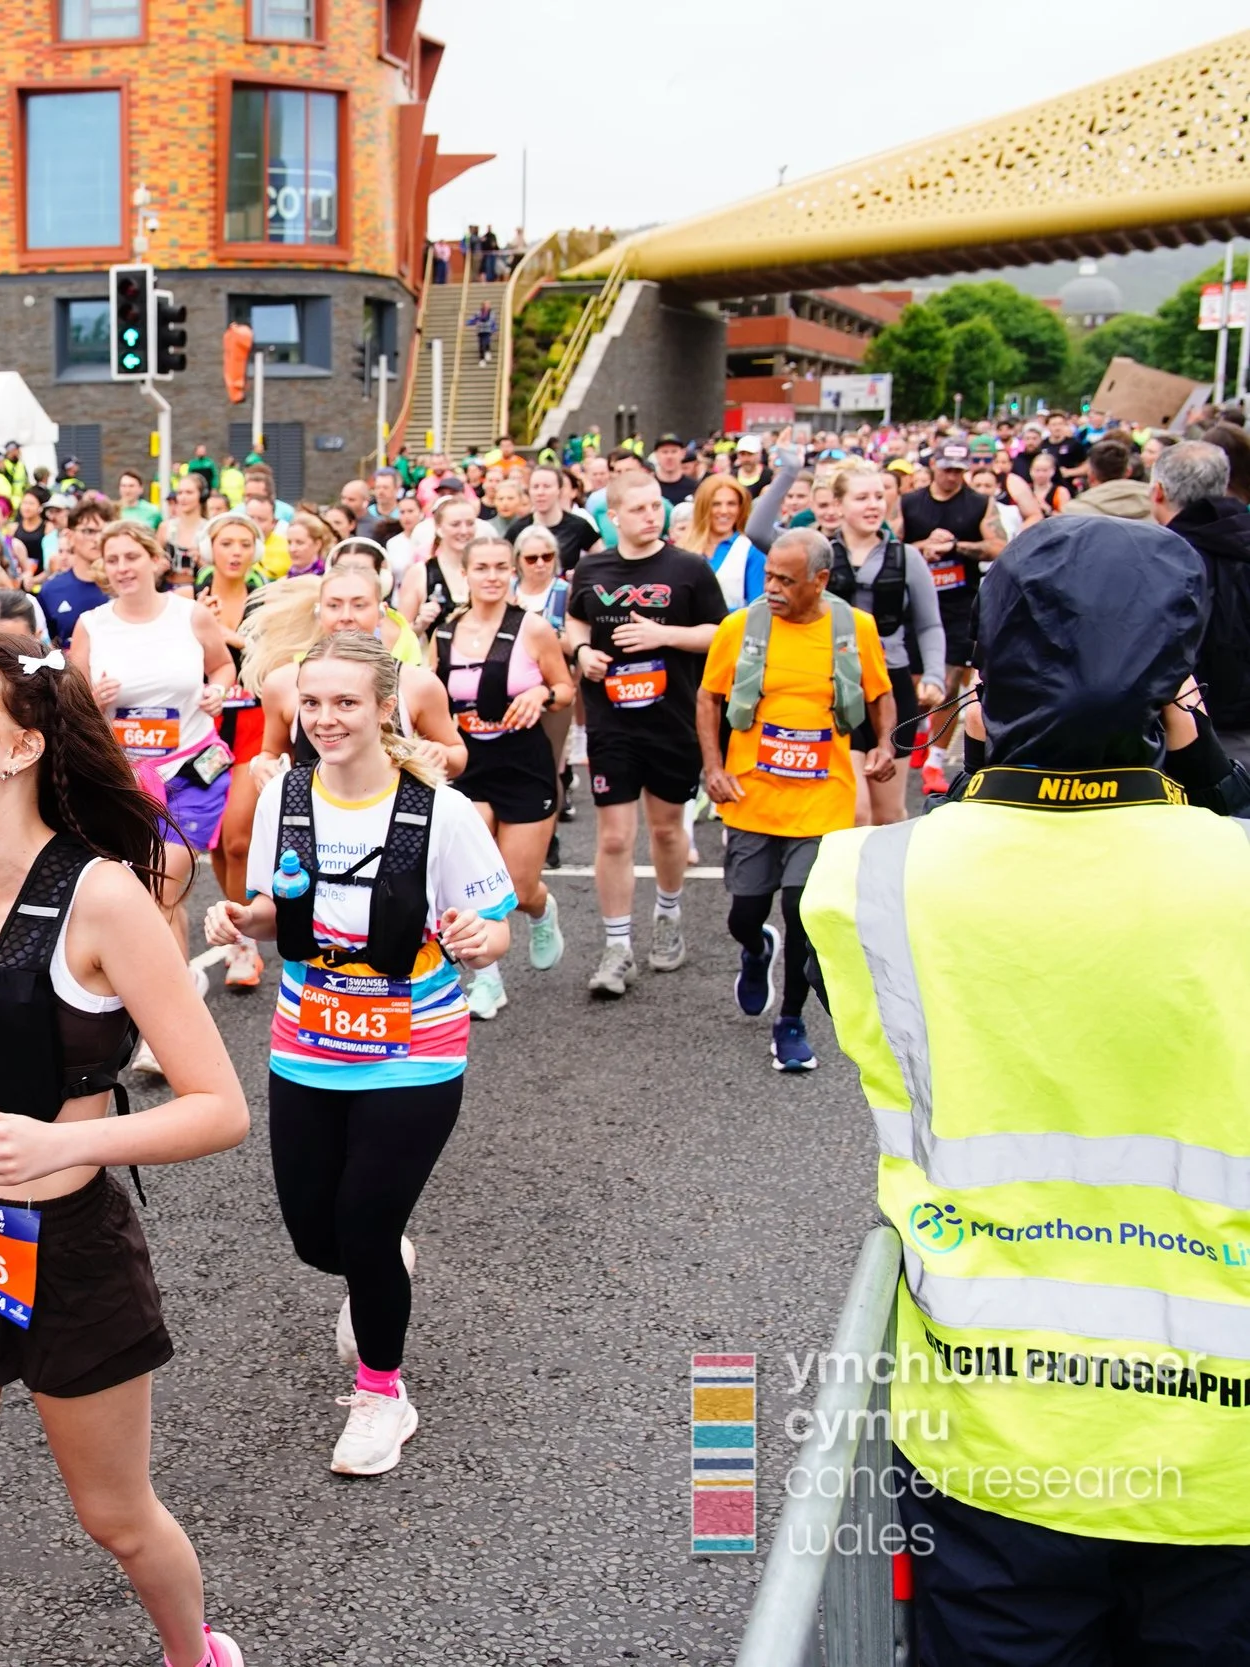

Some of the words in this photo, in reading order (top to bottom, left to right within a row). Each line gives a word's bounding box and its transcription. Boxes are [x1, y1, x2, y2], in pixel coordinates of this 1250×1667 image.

[617, 681, 655, 700] 3202
[124, 729, 166, 746] 6647
[771, 749, 818, 769] 4979
[1038, 777, 1118, 801] Nikon
[316, 842, 366, 855] mchwil
[318, 859, 350, 871] ymru
[348, 977, 388, 986] SWANSEA
[303, 989, 339, 1008] CARYS
[320, 1008, 387, 1038] 1843
[318, 1037, 386, 1054] #RUNSWANSEA
[970, 1218, 1112, 1243] Marathon
[1119, 1223, 1218, 1262] Photos
